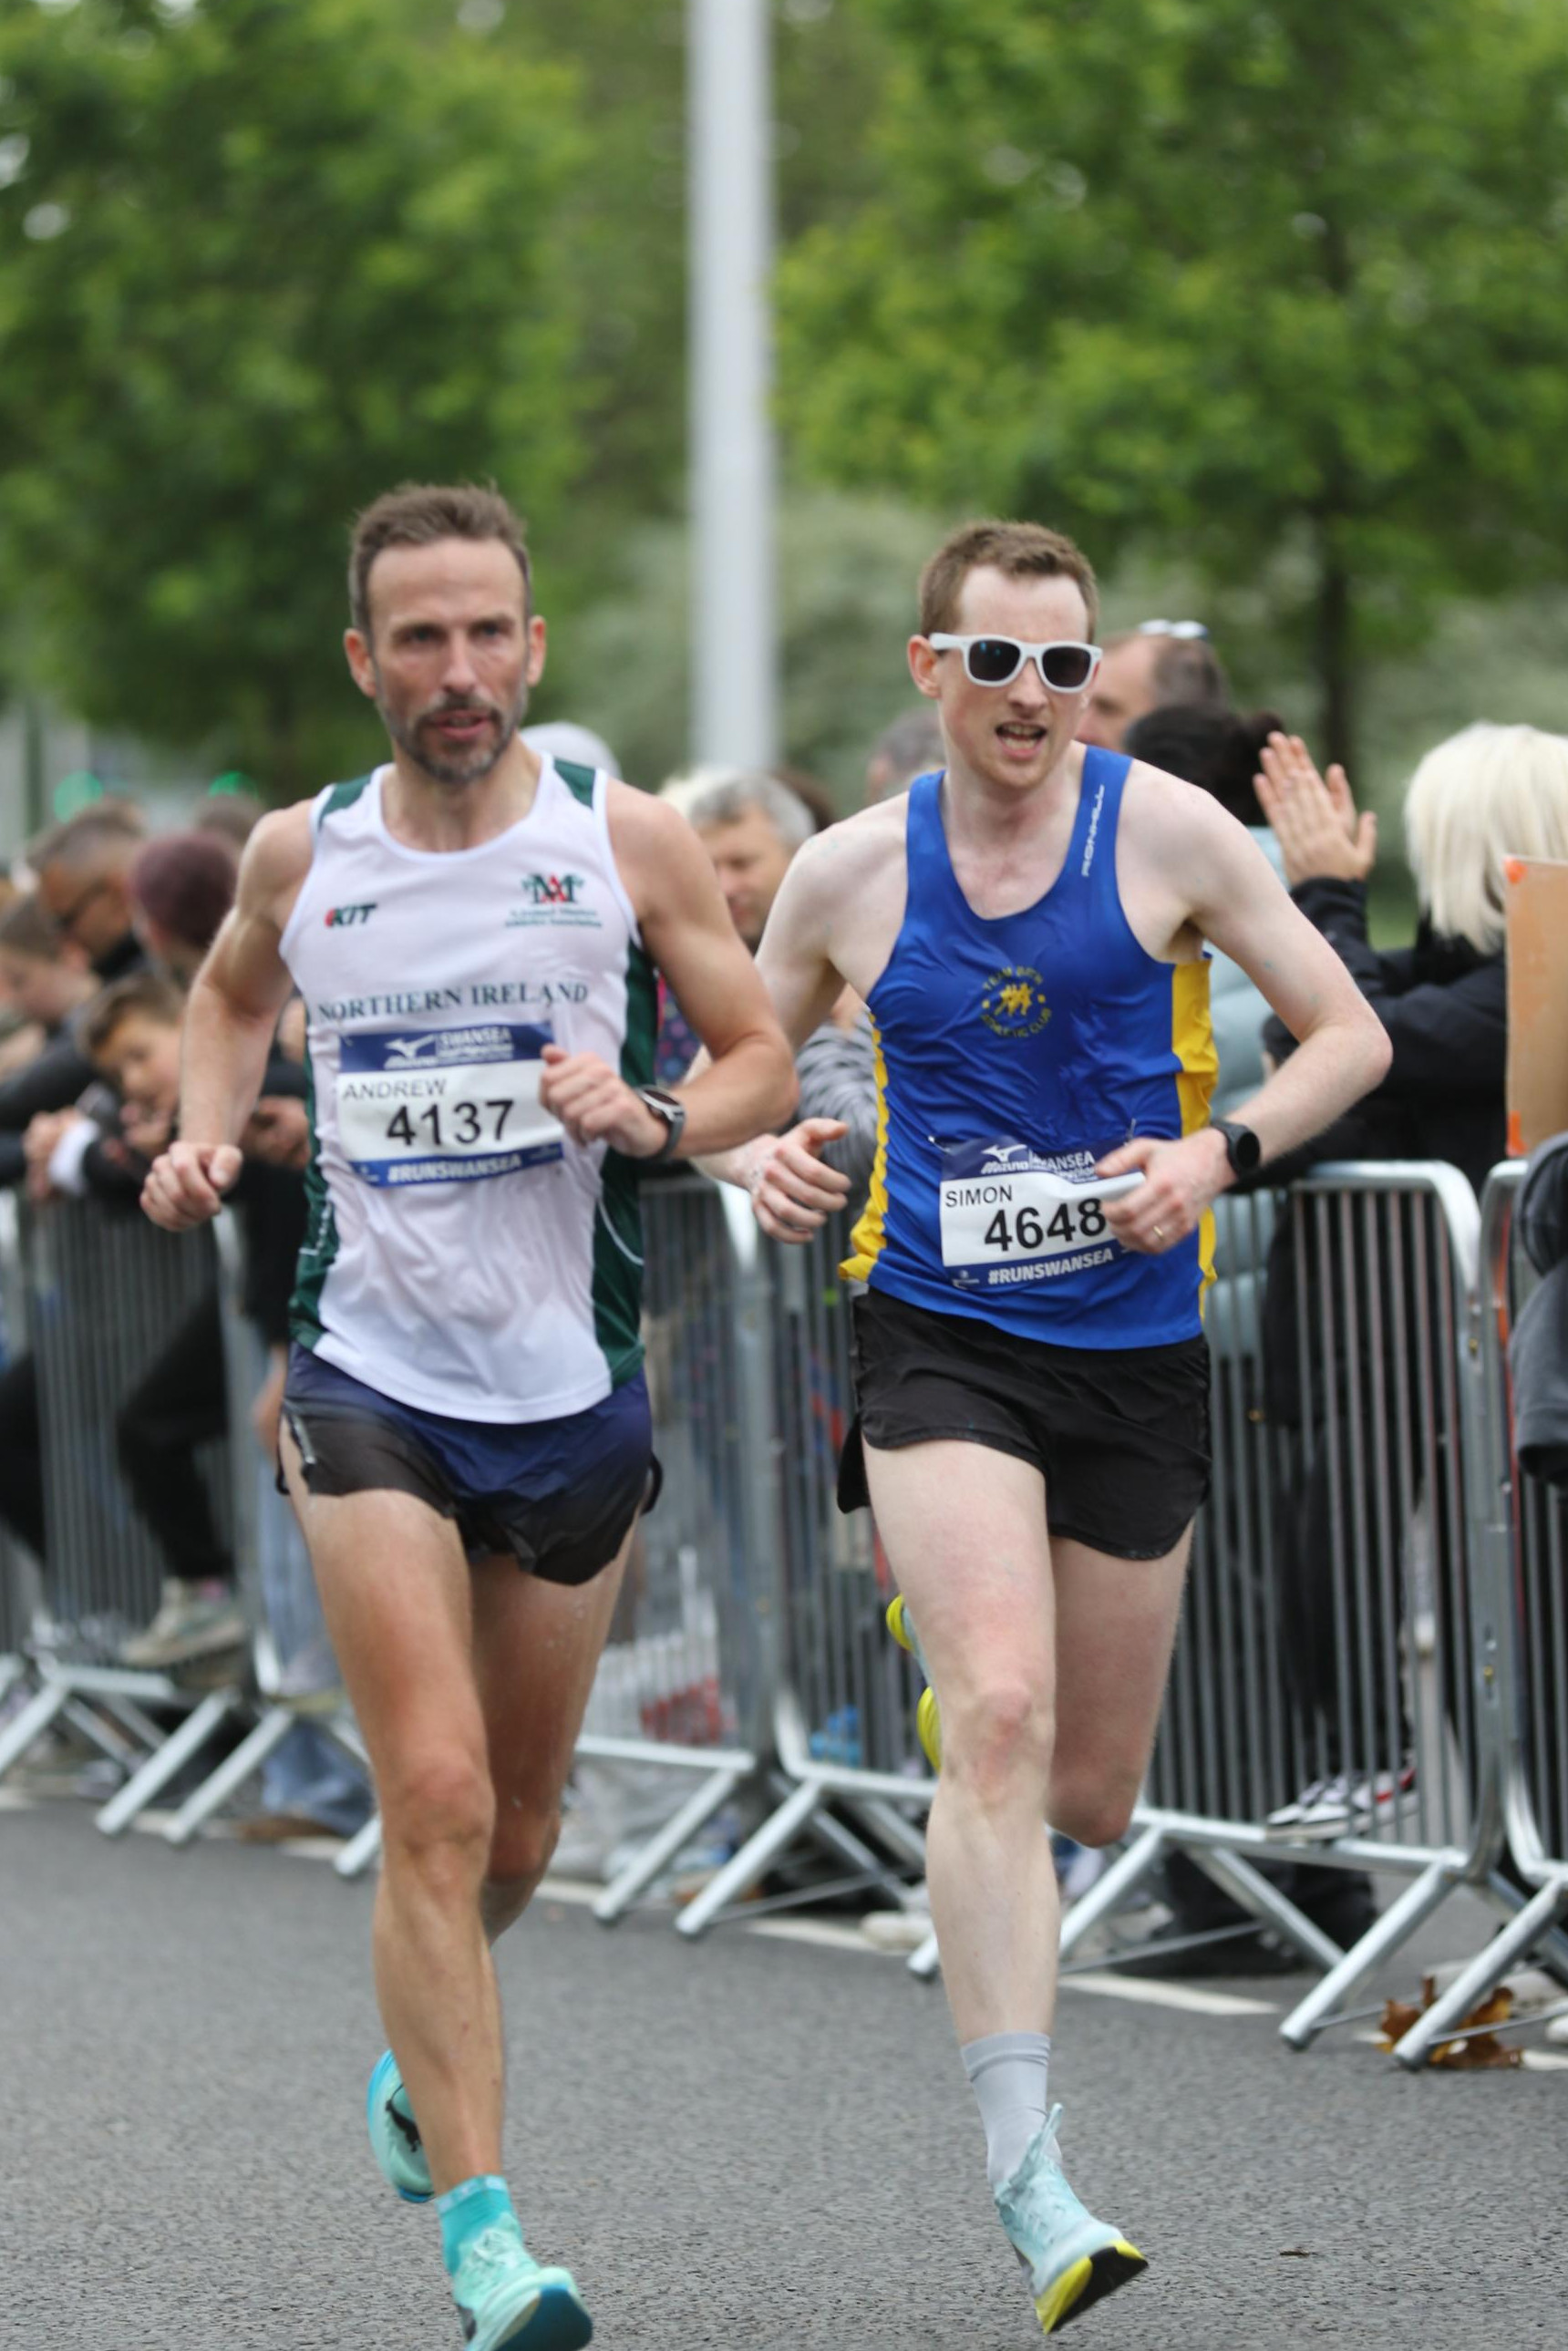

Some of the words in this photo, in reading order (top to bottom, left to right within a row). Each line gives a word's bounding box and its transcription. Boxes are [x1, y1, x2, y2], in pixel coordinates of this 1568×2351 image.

[319, 988, 463, 1022] NORTHERN
[472, 982, 589, 1005] IRELAND
[343, 1078, 447, 1102] ANDREW
[387, 1099, 514, 1146] 4137
[387, 1153, 522, 1183] #RUNSWANSEA
[945, 1184, 1013, 1208] SIMON
[984, 1197, 1107, 1252] 4648
[987, 1247, 1114, 1285] #RUNSWANSEA
